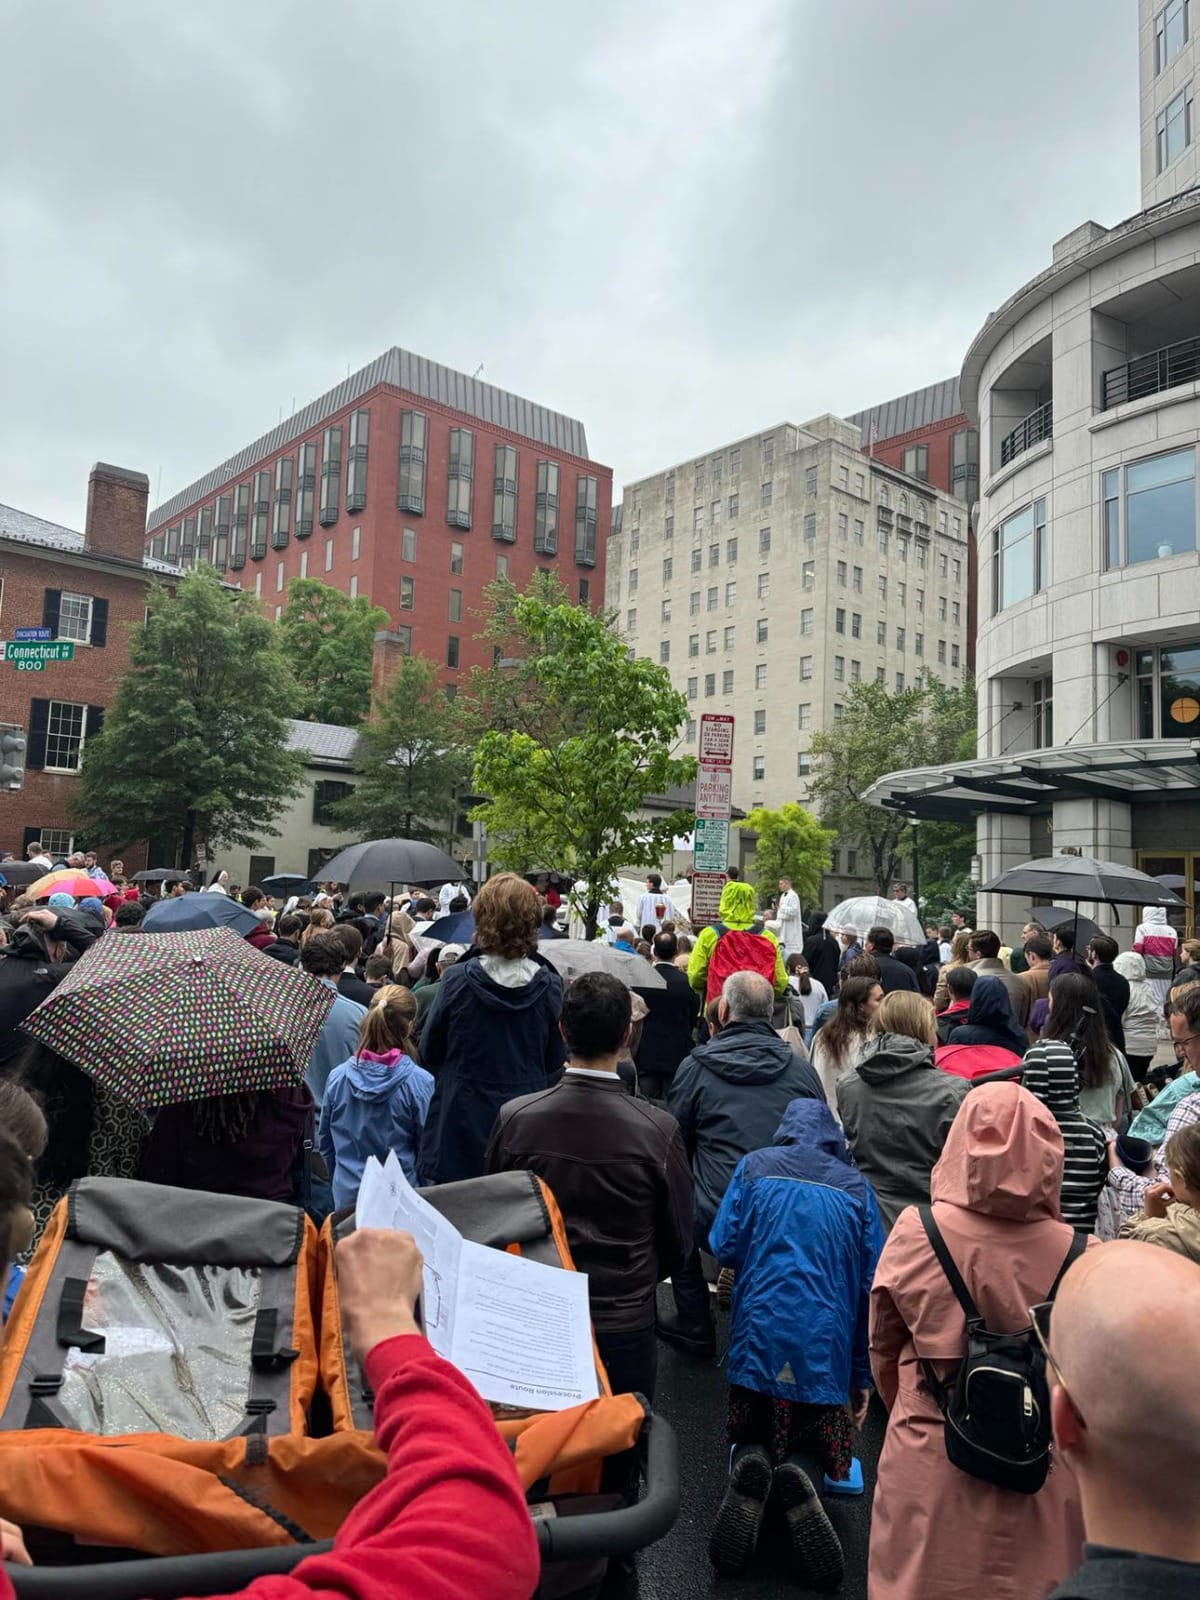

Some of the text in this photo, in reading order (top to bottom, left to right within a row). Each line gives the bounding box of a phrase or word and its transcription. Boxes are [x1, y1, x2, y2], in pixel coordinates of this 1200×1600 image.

[8, 644, 59, 658] Connecticut
[18, 660, 42, 670] 800
[700, 783, 729, 793] PARKING
[699, 793, 729, 803] ANYTIME
[698, 820, 704, 828] 2
[510, 1384, 582, 1399] Procession Route
